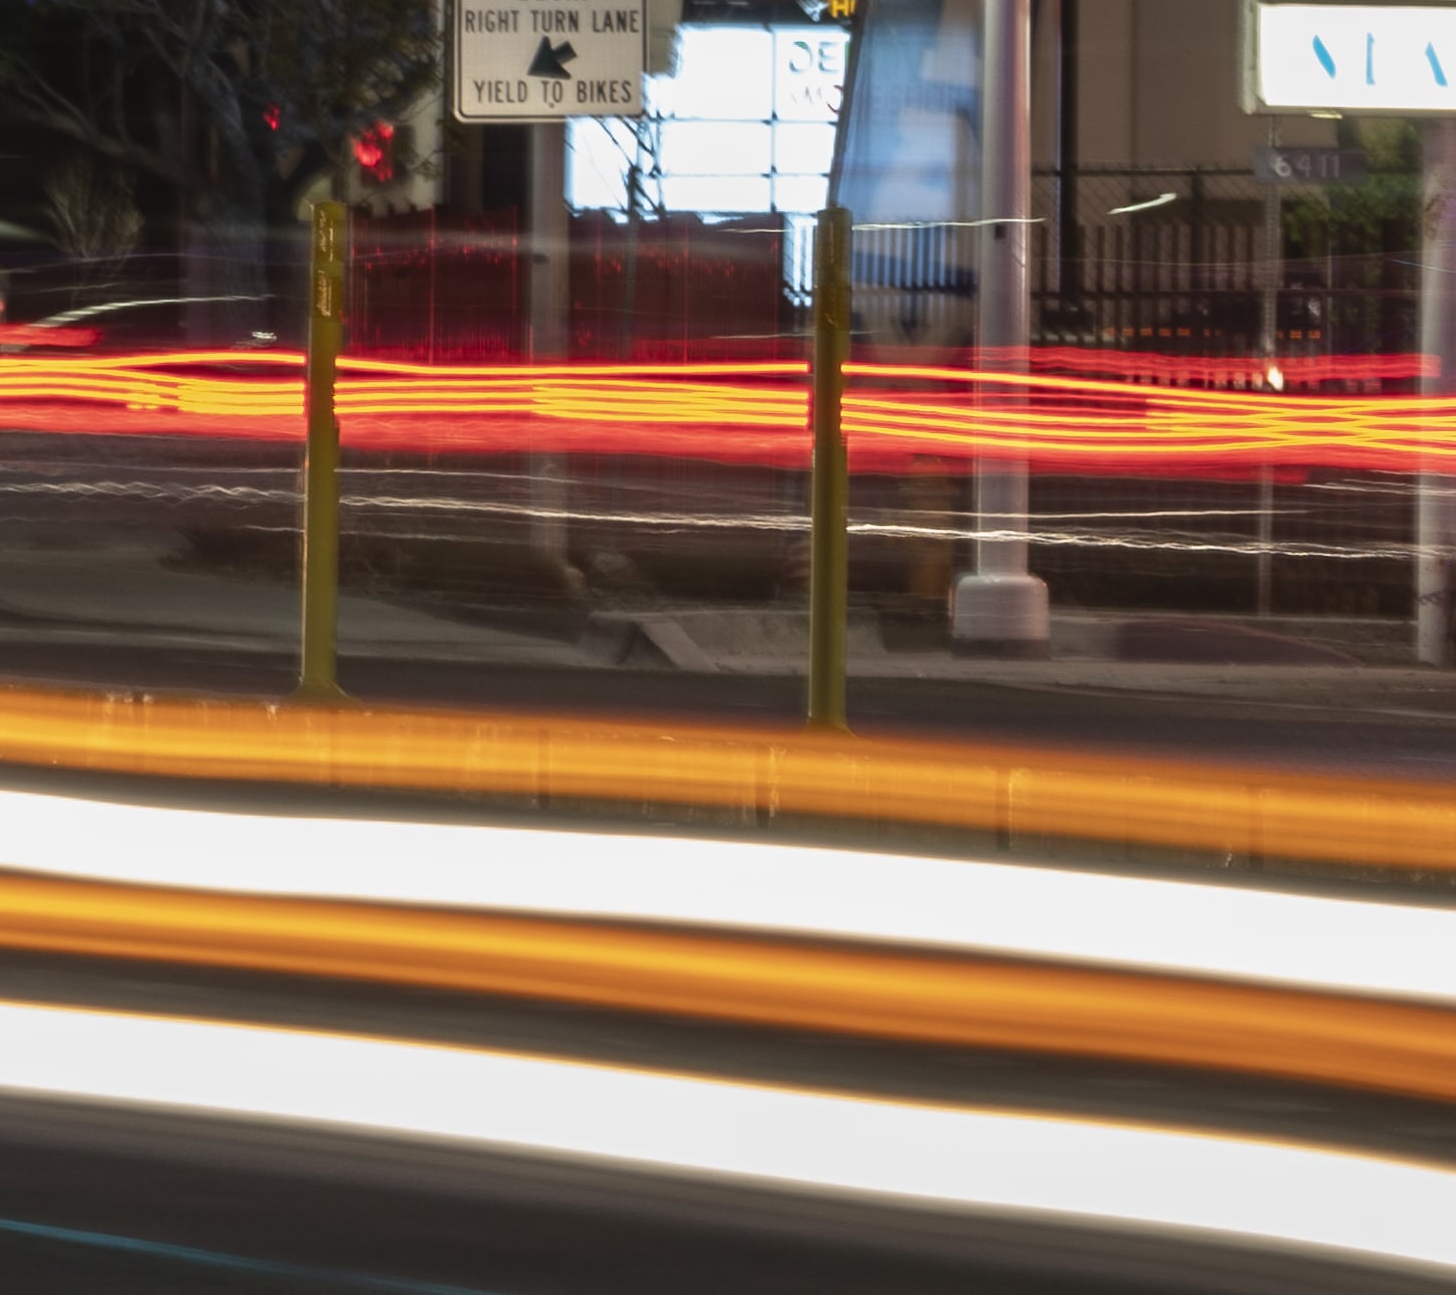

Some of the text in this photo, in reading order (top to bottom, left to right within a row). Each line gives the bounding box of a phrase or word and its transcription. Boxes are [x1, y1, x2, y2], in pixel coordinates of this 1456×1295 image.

[465, 10, 640, 33] RIGHT TURN LANE
[473, 80, 632, 103] YIELD TO BIKES
[1273, 153, 1340, 179] 6411
